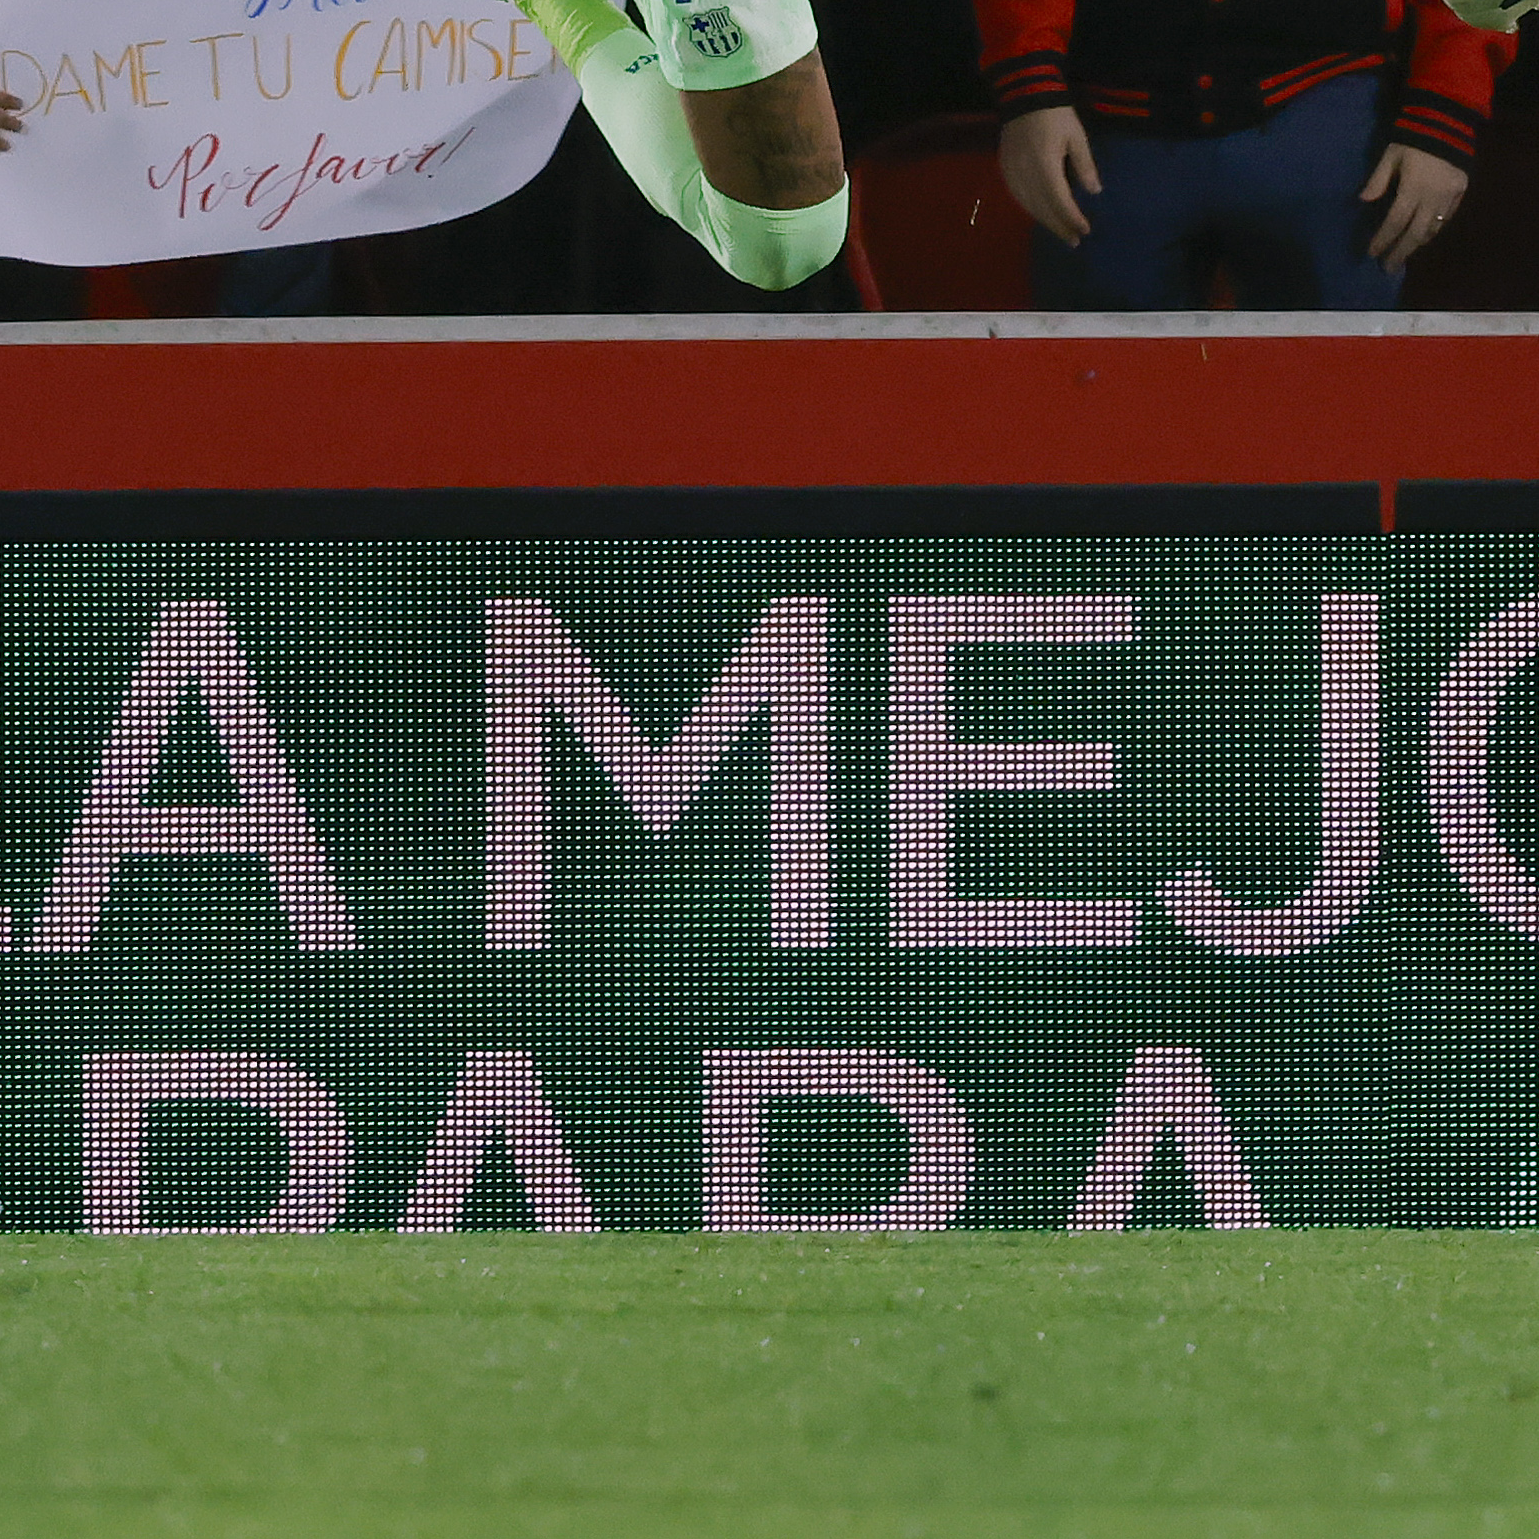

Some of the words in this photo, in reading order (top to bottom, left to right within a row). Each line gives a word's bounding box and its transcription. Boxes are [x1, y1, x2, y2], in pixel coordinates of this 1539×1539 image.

[1, 39, 169, 117] DAME
[189, 31, 293, 101] TU
[334, 18, 558, 101] CAMISE
